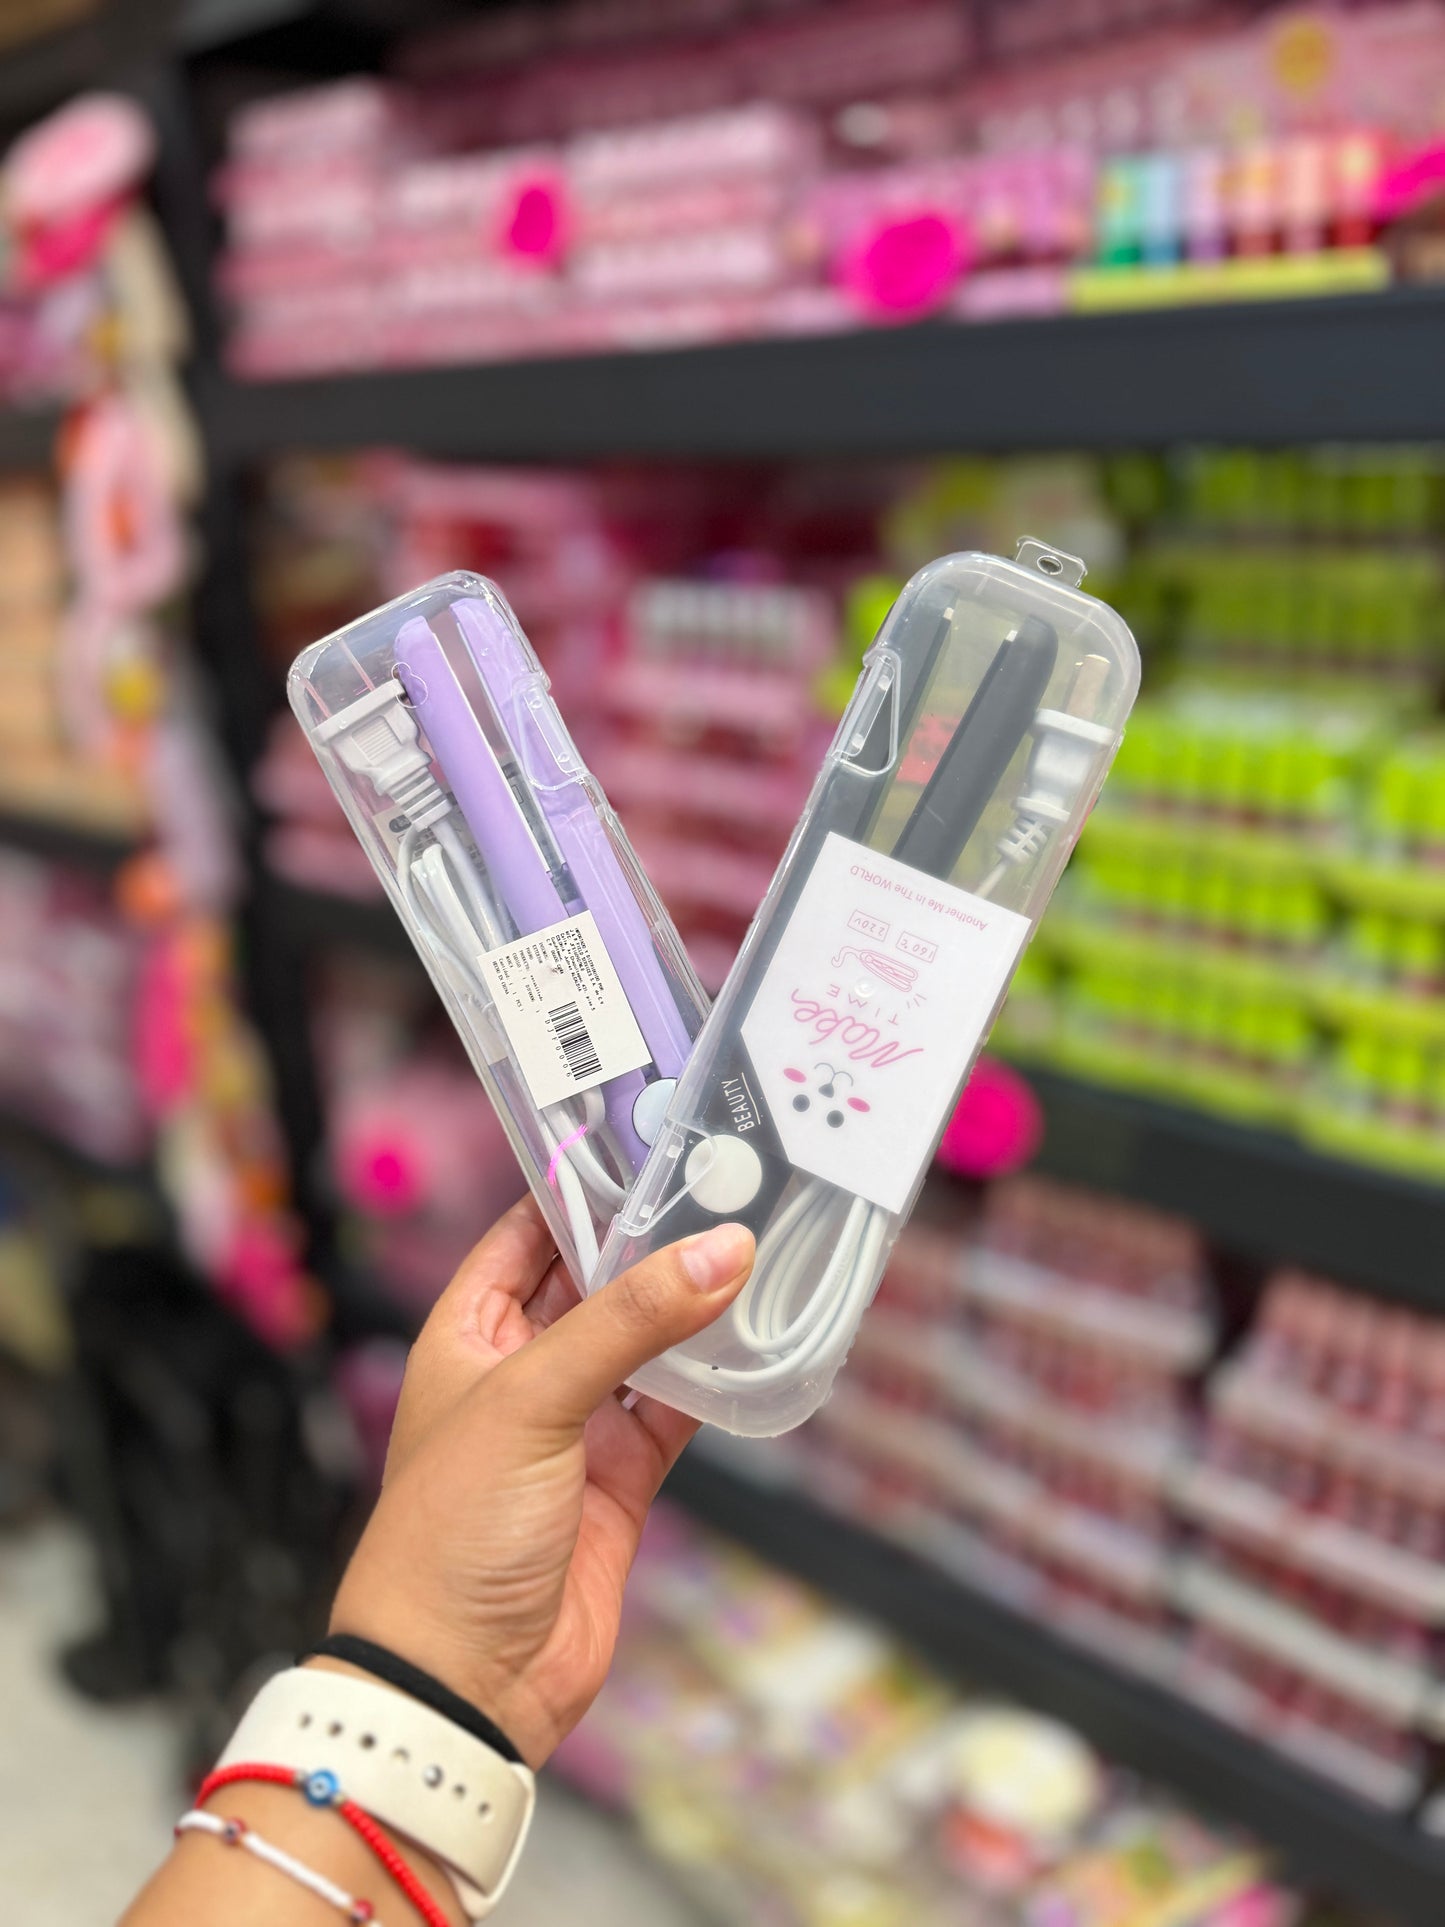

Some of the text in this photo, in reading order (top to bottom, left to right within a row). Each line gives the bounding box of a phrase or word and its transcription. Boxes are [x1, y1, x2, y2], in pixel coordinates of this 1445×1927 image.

[850, 865, 988, 931] Another Me In The WORLD
[790, 988, 924, 1069] Make
[826, 983, 899, 1026] TIME
[721, 1078, 755, 1132] BEAUTY
